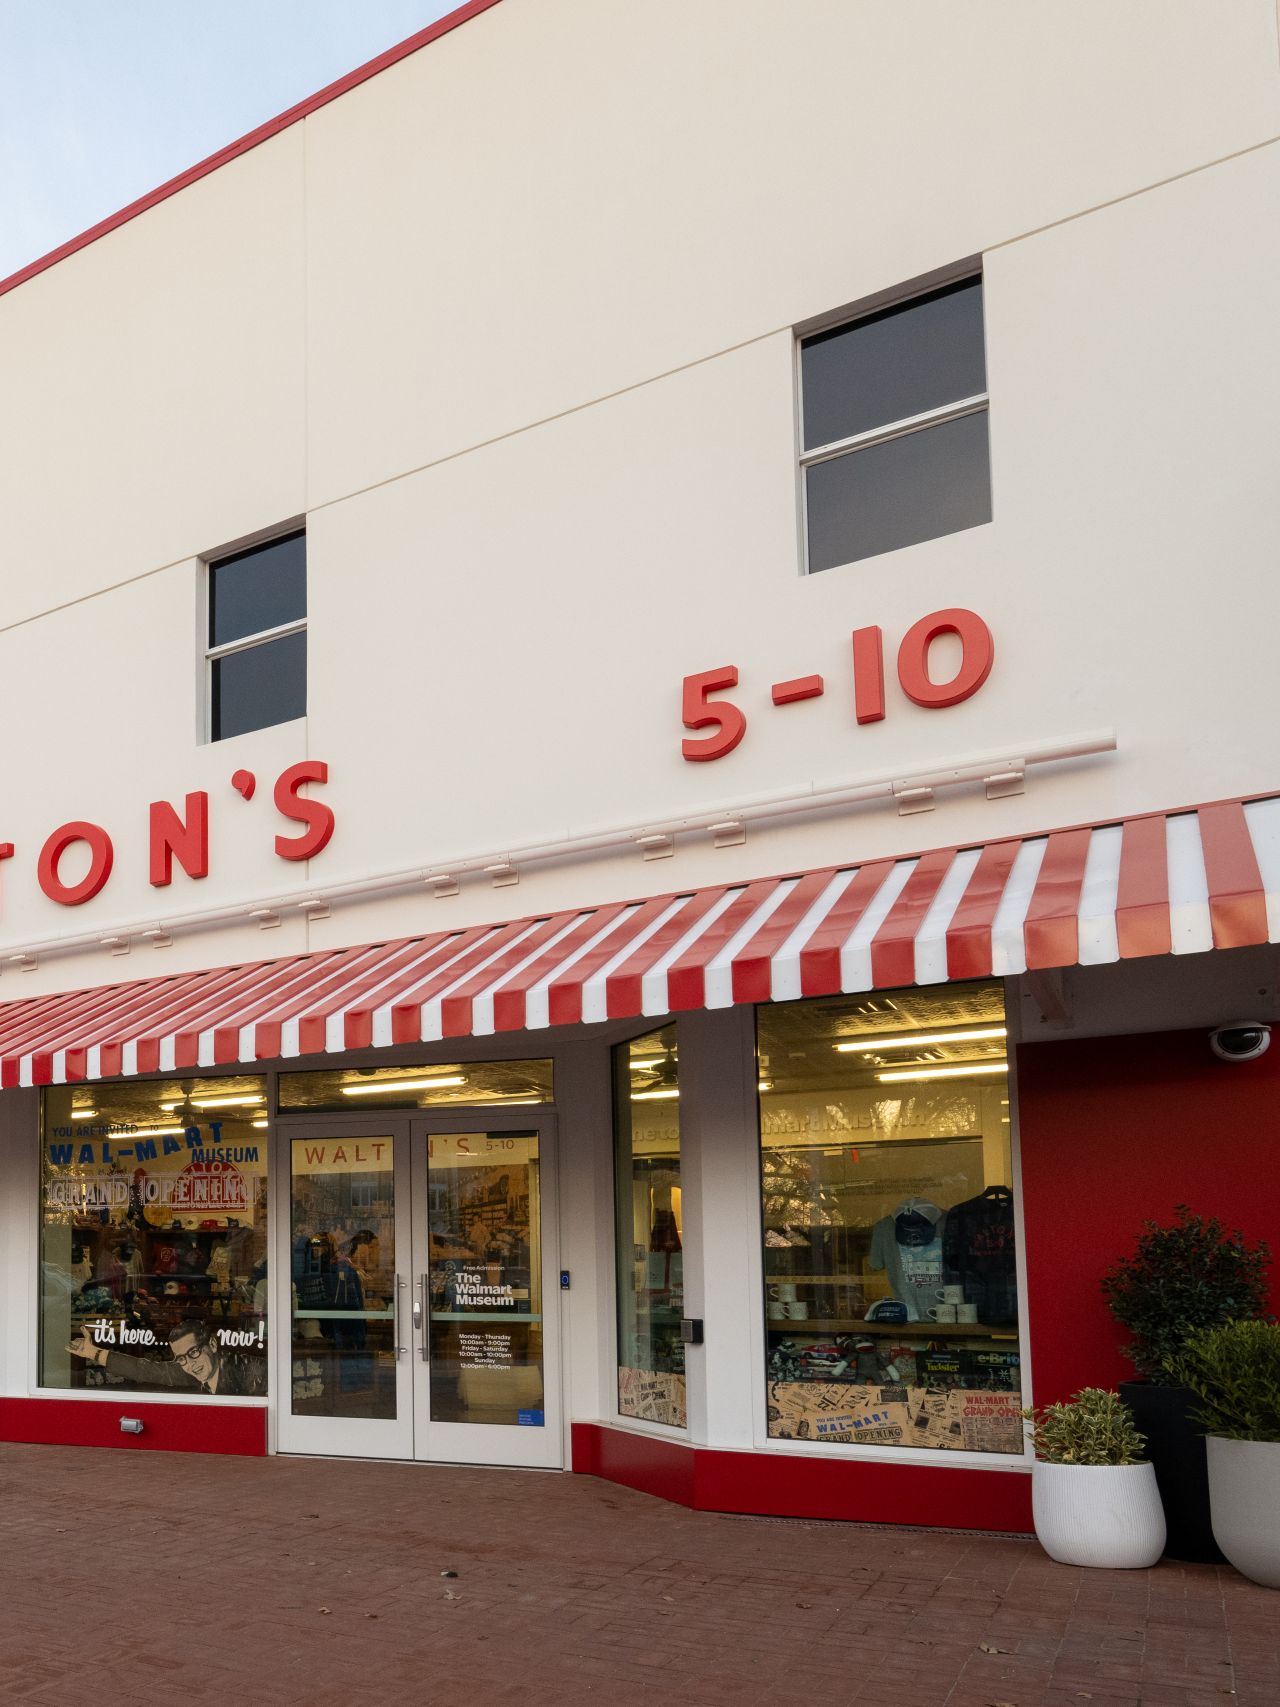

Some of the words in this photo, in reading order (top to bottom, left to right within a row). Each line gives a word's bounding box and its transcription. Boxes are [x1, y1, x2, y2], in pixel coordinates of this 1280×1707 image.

[681, 607, 995, 762] 5-10
[52, 1126, 73, 1137] YOU
[76, 1126, 95, 1136] ARE
[50, 1122, 223, 1165] WAL-MART
[486, 1139, 514, 1150] 5-10
[191, 1147, 258, 1164] MUSEUM
[53, 1181, 128, 1203] GRAND
[455, 1272, 481, 1283] The
[455, 1284, 512, 1295] Walmart
[456, 1295, 514, 1306] Museum
[87, 1319, 115, 1343] it's
[217, 1321, 264, 1349] now!
[966, 1396, 1009, 1404] WAL-MART
[963, 1406, 994, 1416] GRAND
[817, 1411, 889, 1433] WAL-MART
[855, 1428, 901, 1440] OPENING
